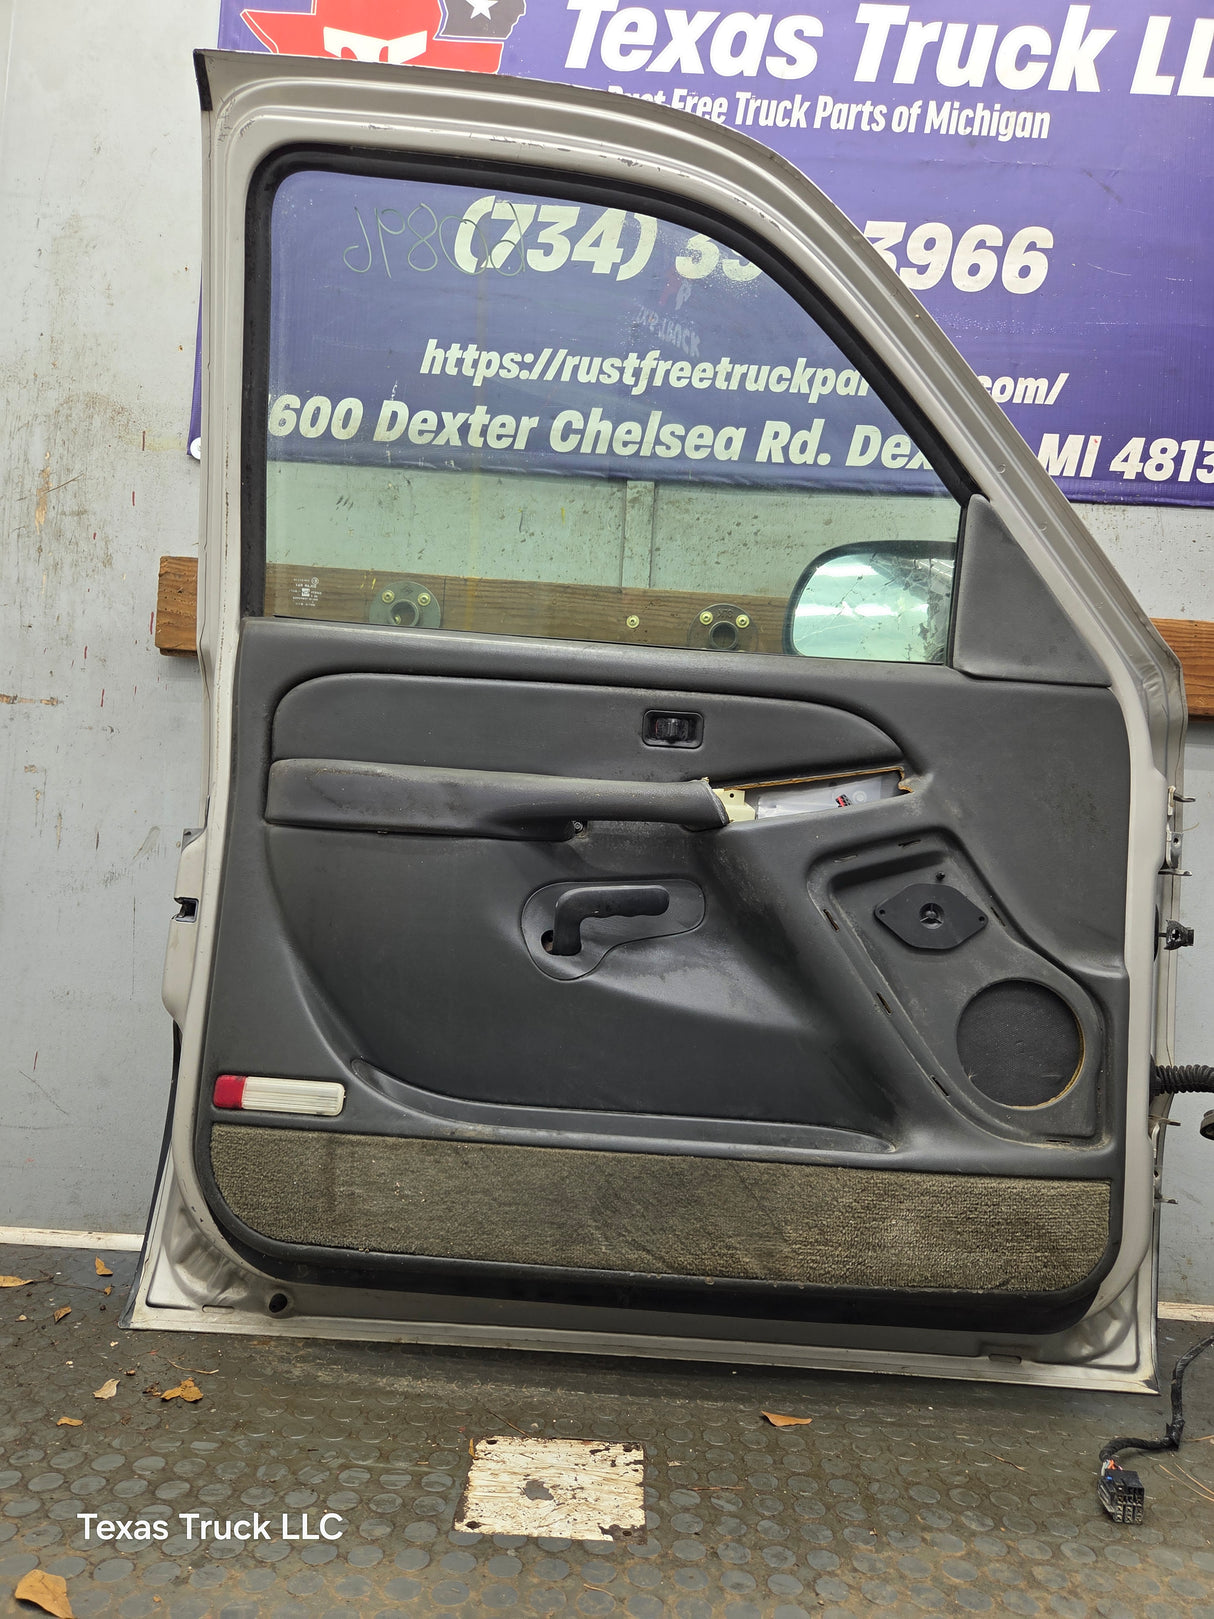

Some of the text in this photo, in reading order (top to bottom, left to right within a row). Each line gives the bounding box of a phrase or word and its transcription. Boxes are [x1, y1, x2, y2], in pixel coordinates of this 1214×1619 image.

[565, 0, 824, 80] Texas
[853, 2, 1118, 93] Truck
[734, 91, 812, 129] Truck
[813, 94, 888, 132] Parts
[891, 99, 923, 133] of
[923, 100, 1051, 142] Michigan
[453, 194, 658, 282] (734)
[373, 398, 540, 450] Dexter
[549, 407, 748, 461] Chelsea
[755, 418, 831, 466] Rd.
[1036, 433, 1102, 478] MI
